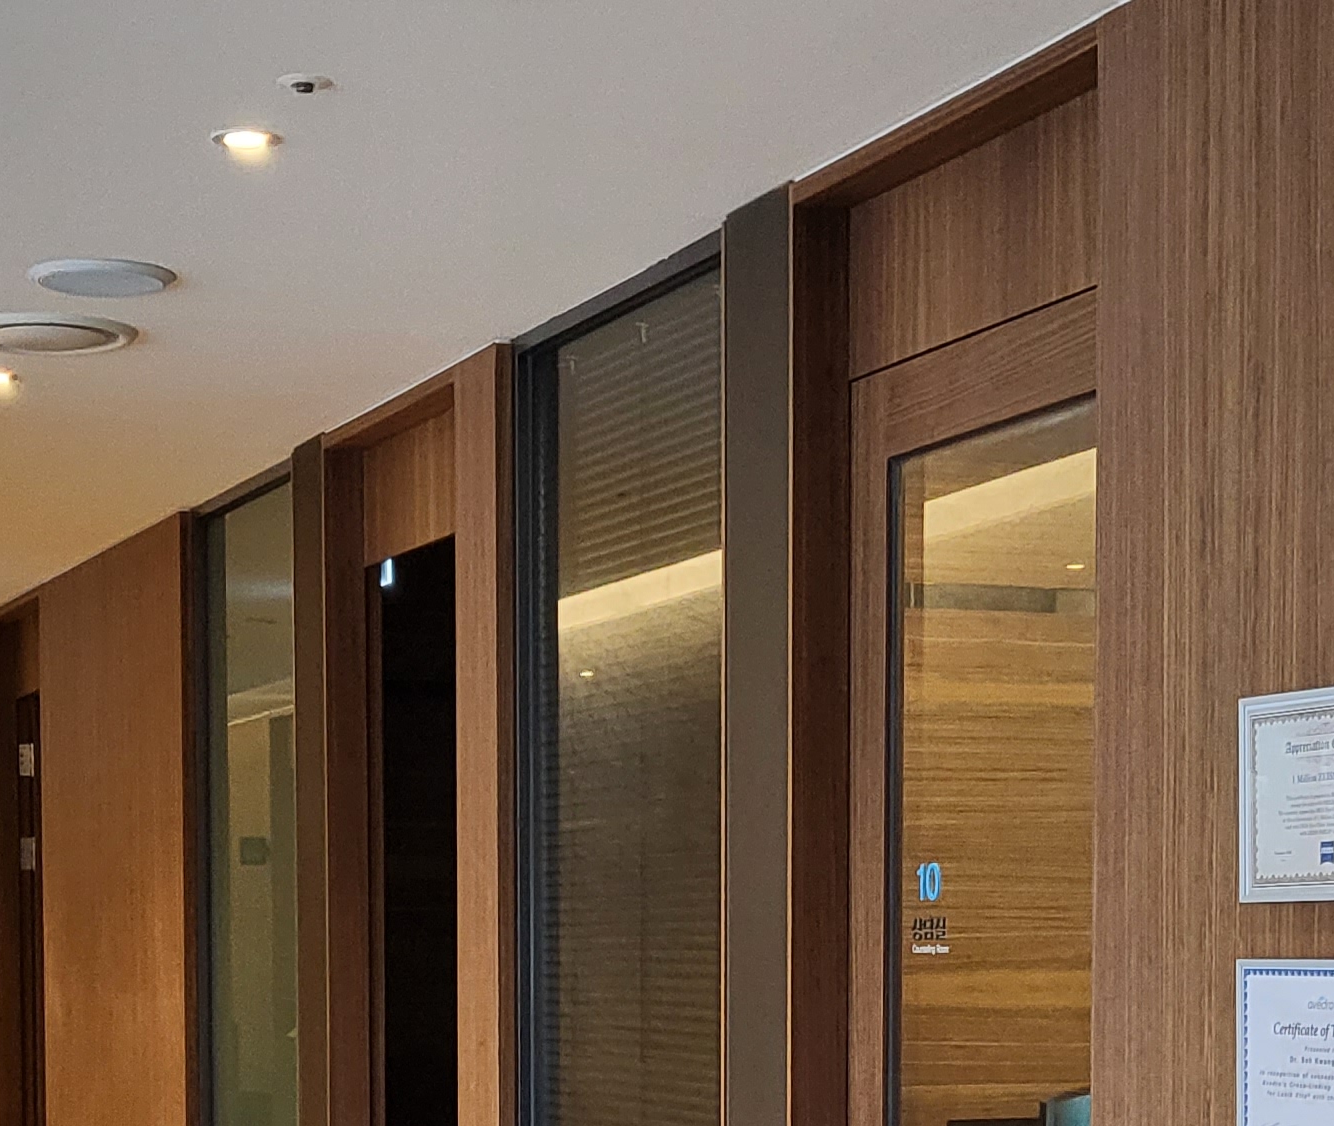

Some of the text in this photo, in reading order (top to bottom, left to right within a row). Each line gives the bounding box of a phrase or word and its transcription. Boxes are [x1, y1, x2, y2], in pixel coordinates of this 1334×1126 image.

[916, 862, 942, 902] 10
[912, 916, 947, 941] 상담실
[1273, 1022, 1319, 1040] Certificate
[1320, 1024, 1331, 1041] of
